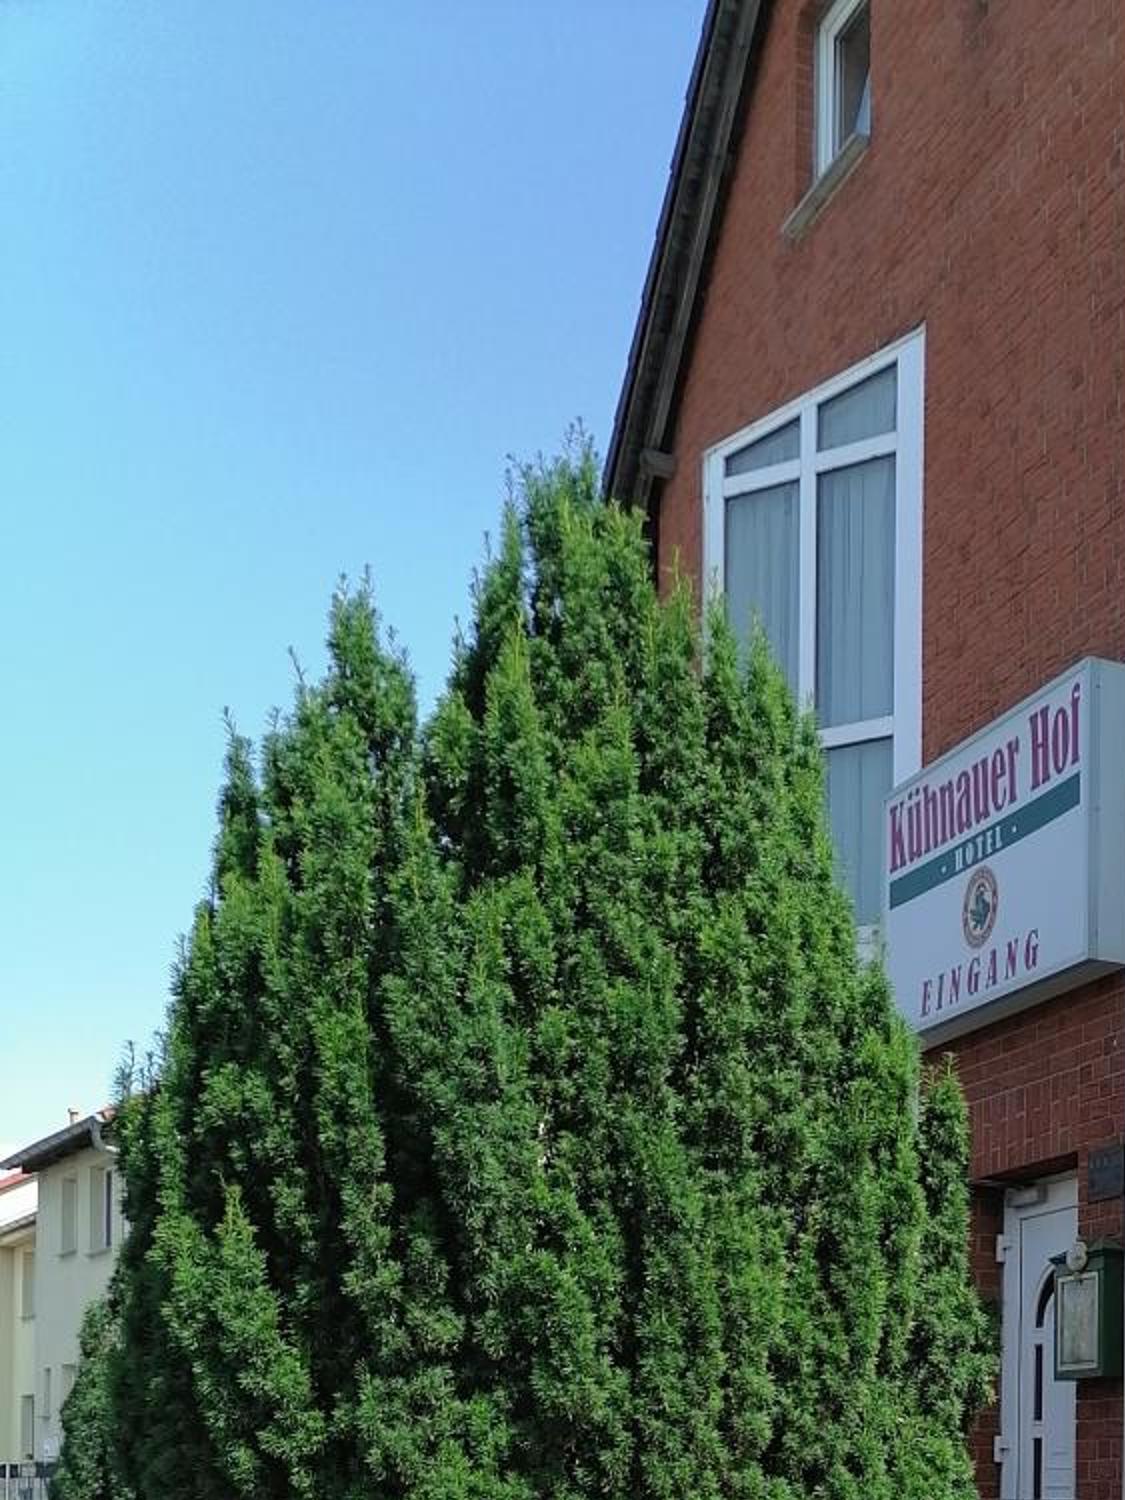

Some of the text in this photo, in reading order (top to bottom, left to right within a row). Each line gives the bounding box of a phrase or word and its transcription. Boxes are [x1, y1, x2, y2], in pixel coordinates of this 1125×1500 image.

[889, 683, 1081, 873] Kühnauer Hof
[955, 826, 1003, 872] HOTEL
[920, 929, 1040, 1017] EINGANG
